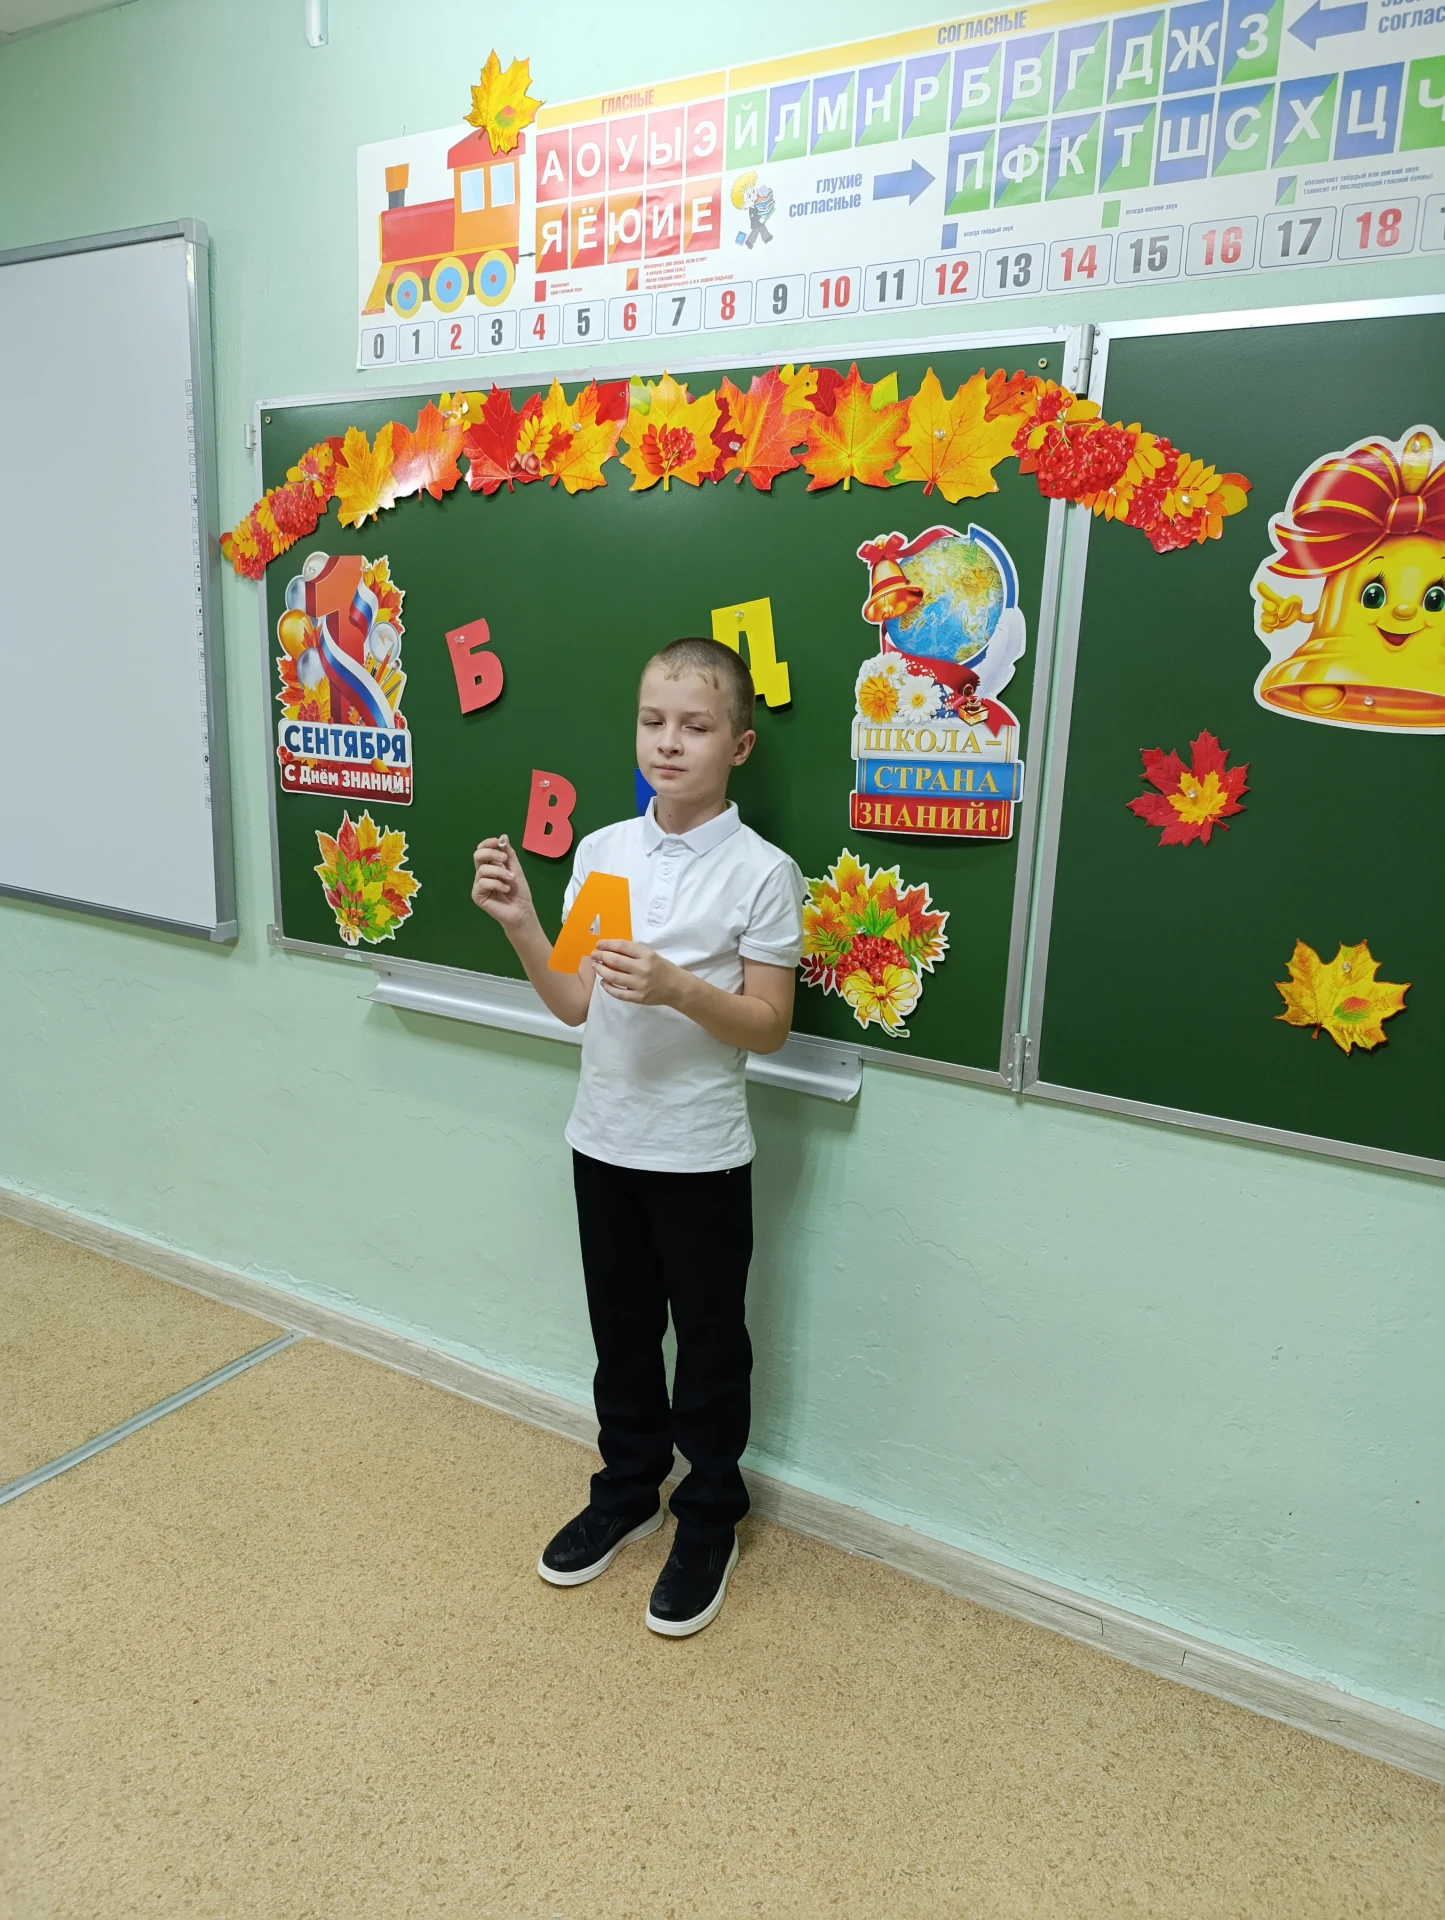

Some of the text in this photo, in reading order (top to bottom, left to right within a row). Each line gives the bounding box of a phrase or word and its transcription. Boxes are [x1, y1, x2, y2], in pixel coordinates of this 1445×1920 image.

[937, 10, 1028, 45] СОГЛАСНЫЕ
[601, 89, 655, 114] ГЛАСНЫЕ
[734, 13, 1269, 150] Й Л М Н Р Б В Г Д Ж З
[541, 120, 717, 185] А О У Ы Э
[956, 150, 985, 192] П
[1001, 144, 1040, 184] Ф
[1058, 133, 1088, 177] К
[1114, 124, 1144, 168] Т
[1160, 113, 1210, 162] Ш
[1225, 106, 1262, 151] С
[1283, 95, 1325, 144] Х
[1347, 86, 1387, 140] Ц
[789, 193, 862, 217] согласные
[816, 173, 863, 194] глухие
[540, 196, 713, 255] Я Ё Ю И Е
[374, 333, 384, 359] 0
[412, 329, 420, 355] 1
[450, 324, 462, 351] 2
[491, 318, 504, 346] 3
[533, 313, 546, 341] 4
[577, 308, 591, 337] 5
[623, 302, 637, 331] 6
[671, 297, 686, 327] 7
[720, 290, 736, 321] 8
[772, 283, 788, 315] 9
[819, 275, 850, 309] 10
[876, 268, 905, 303] 11
[935, 260, 969, 296] 12
[996, 252, 1032, 289] 13
[1061, 244, 1098, 282] 14
[1129, 235, 1170, 274] 15
[1202, 226, 1243, 266] 16
[1278, 217, 1322, 257] 17
[1356, 208, 1403, 249] 18
[445, 617, 504, 715] Б
[284, 725, 407, 763] СЕНТЯБРЯ
[284, 764, 410, 795] С Днём ЗНАНИЙ!
[874, 766, 999, 793] СТРАНА
[521, 769, 577, 859] В
[859, 801, 999, 832] ЗНАНИЙ!
[547, 870, 633, 975] А
